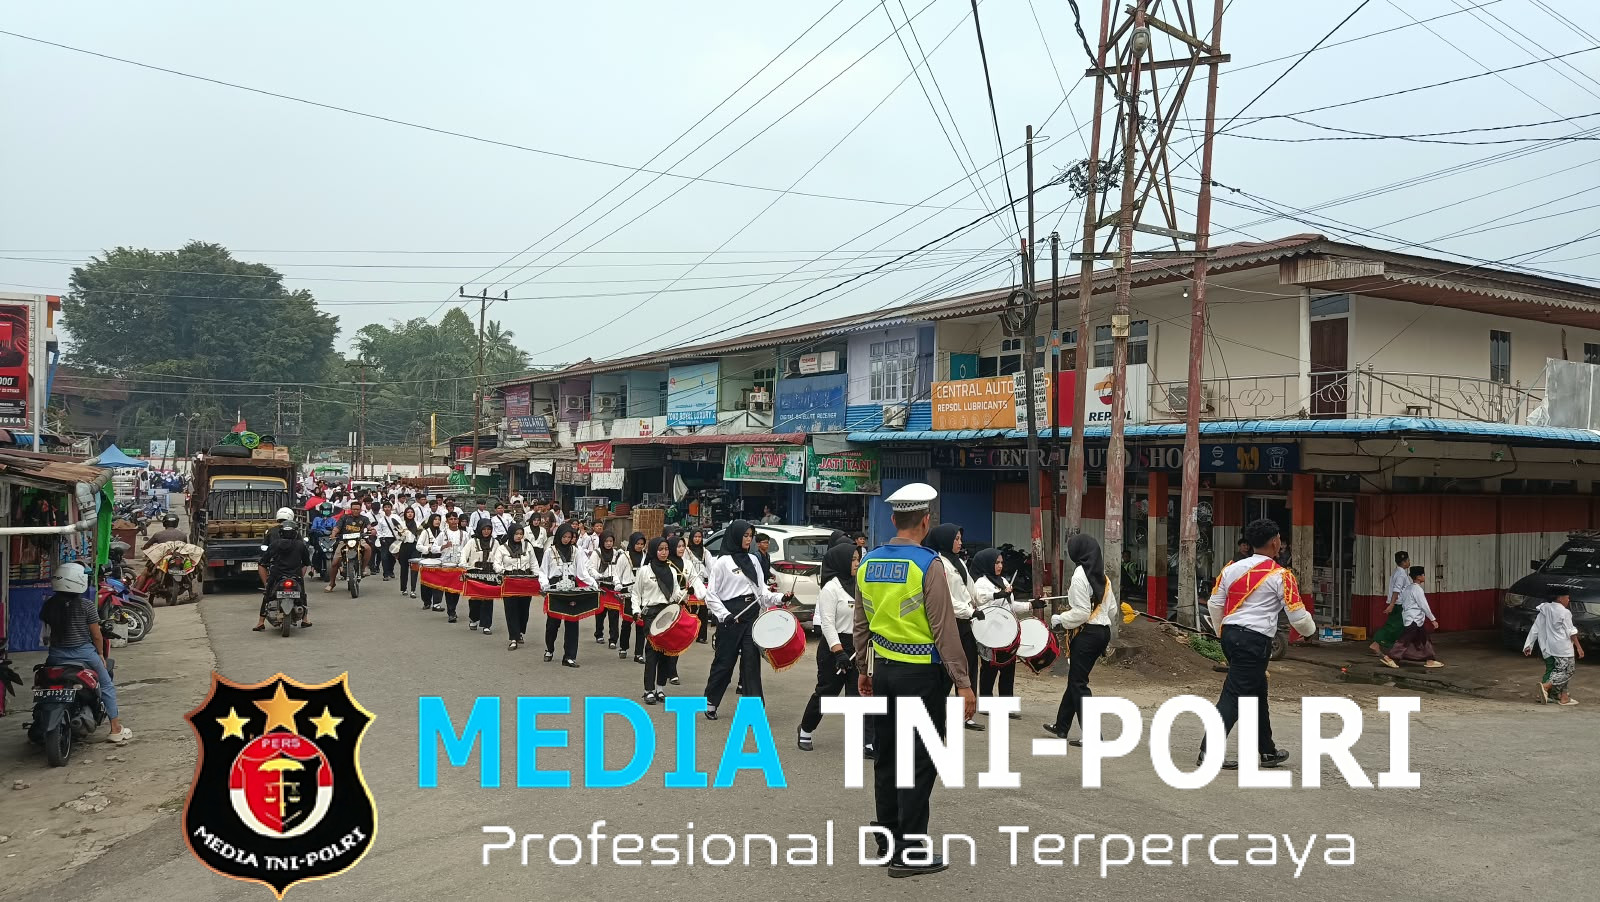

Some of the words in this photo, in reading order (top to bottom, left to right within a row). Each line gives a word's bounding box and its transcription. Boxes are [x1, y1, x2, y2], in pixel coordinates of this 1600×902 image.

[937, 383, 982, 399] CENTRAL
[937, 402, 961, 412] REPSOL
[963, 400, 1008, 411] LUBRICANTS
[1088, 411, 1132, 421] REPL
[745, 453, 763, 467] JATI
[764, 453, 783, 467] TANI
[818, 457, 843, 470] JATI
[845, 458, 871, 471] TANI
[1139, 447, 1184, 468] SHO
[866, 561, 908, 580] POLISI
